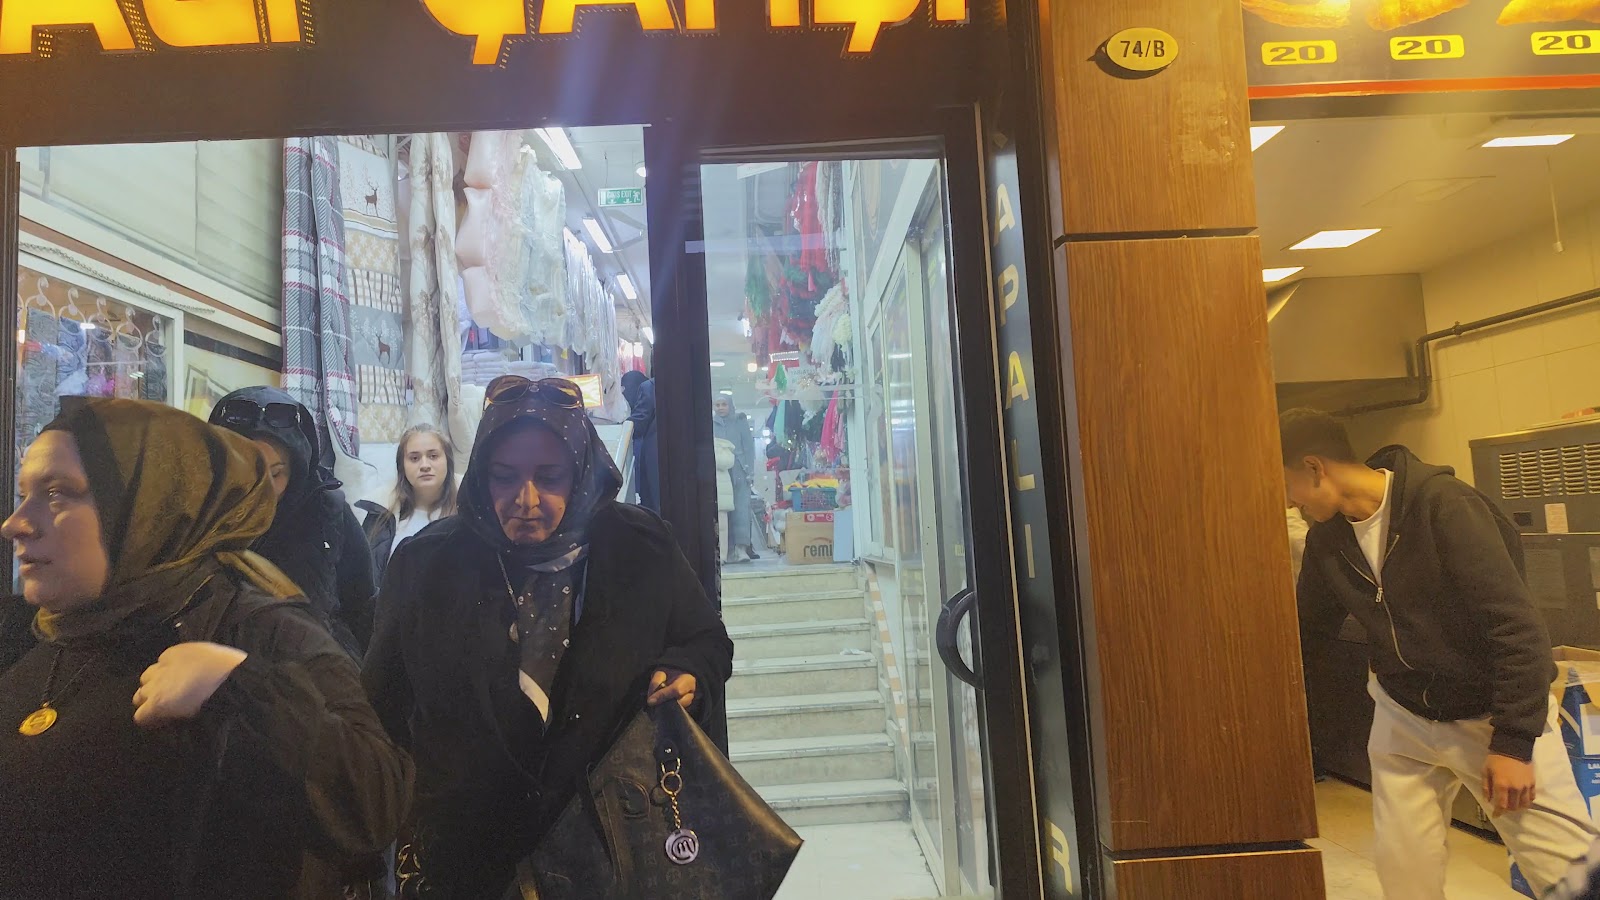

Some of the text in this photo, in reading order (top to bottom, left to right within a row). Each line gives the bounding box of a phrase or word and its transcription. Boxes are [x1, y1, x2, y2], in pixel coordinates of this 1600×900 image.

[1120, 40, 1165, 58] 74/B
[1397, 39, 1451, 56] 20
[1539, 34, 1592, 51] 20
[1270, 45, 1325, 62] 20
[621, 190, 632, 198] EXIT
